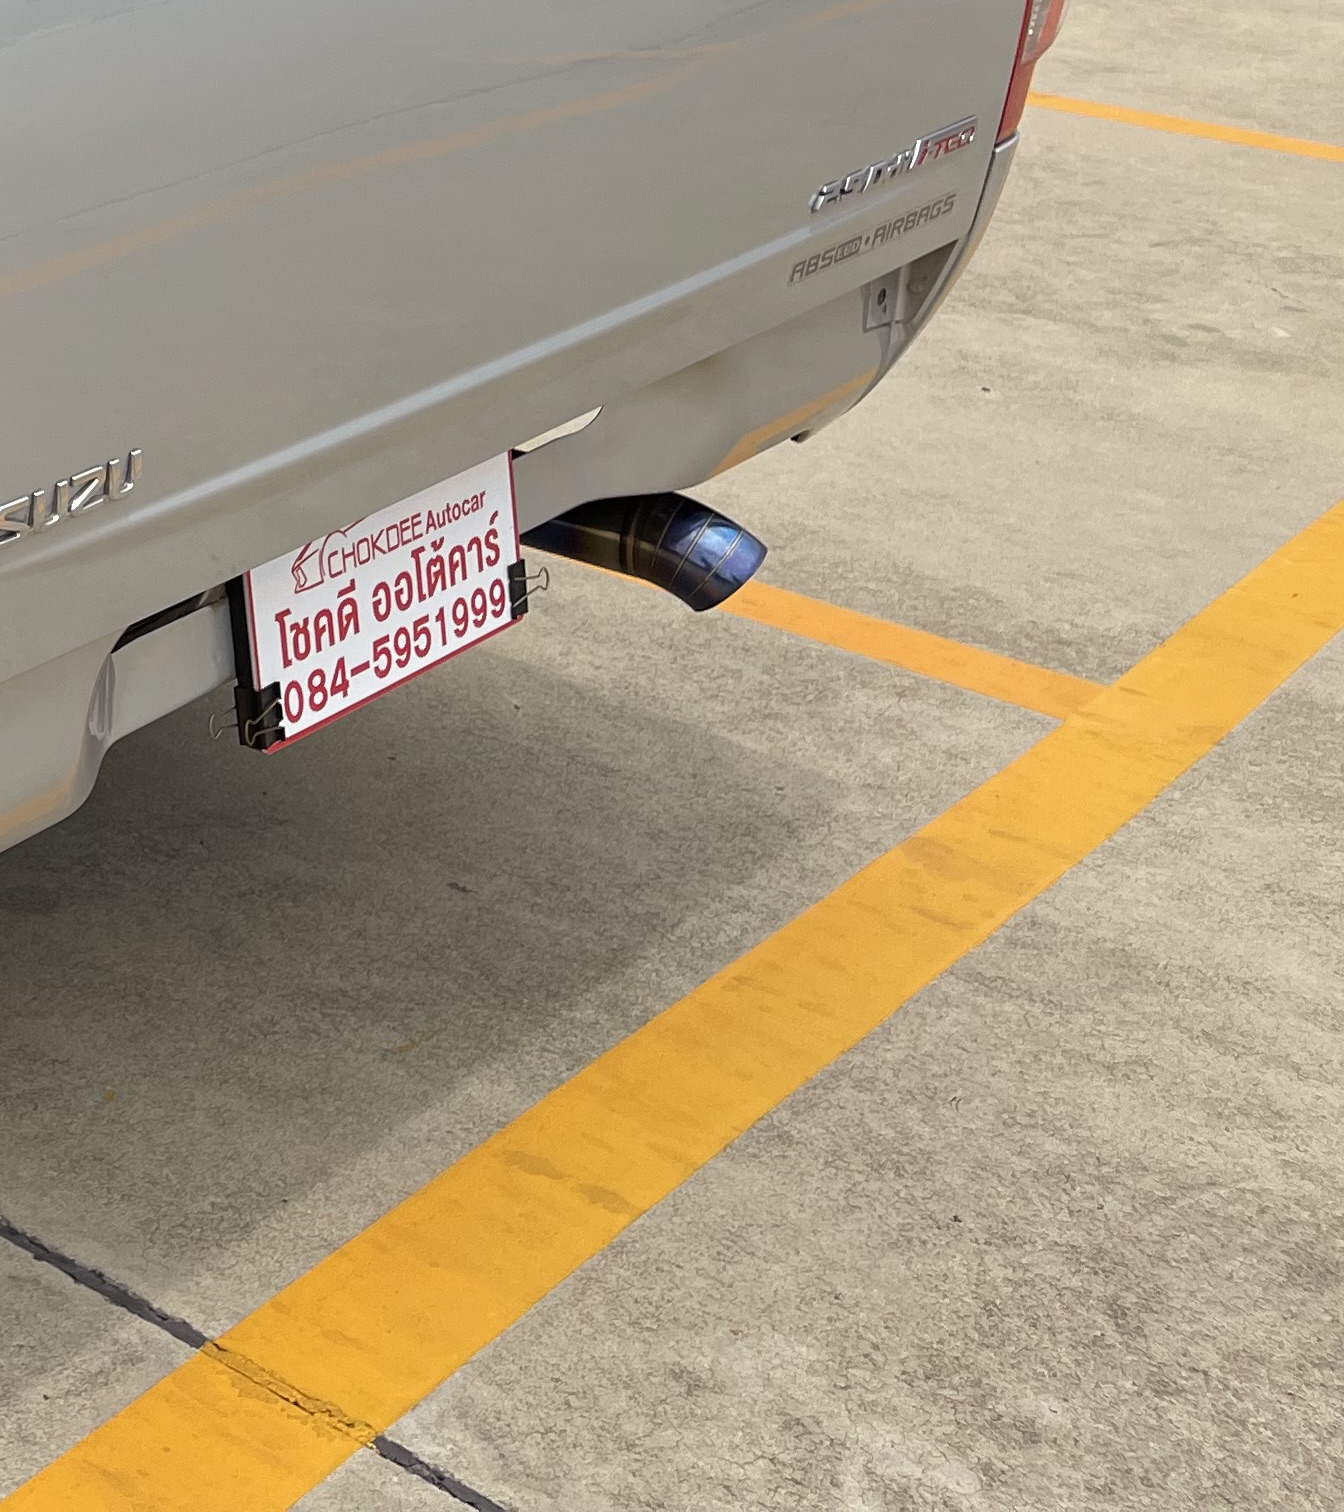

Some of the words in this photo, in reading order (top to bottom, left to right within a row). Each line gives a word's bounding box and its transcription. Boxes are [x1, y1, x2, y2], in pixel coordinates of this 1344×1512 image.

[273, 577, 361, 669] โชคดี
[370, 509, 501, 622] ออโต้คาร์
[327, 511, 423, 579] CHOKDEE
[425, 490, 487, 535] Autocar
[283, 577, 506, 724] 084-5951999
